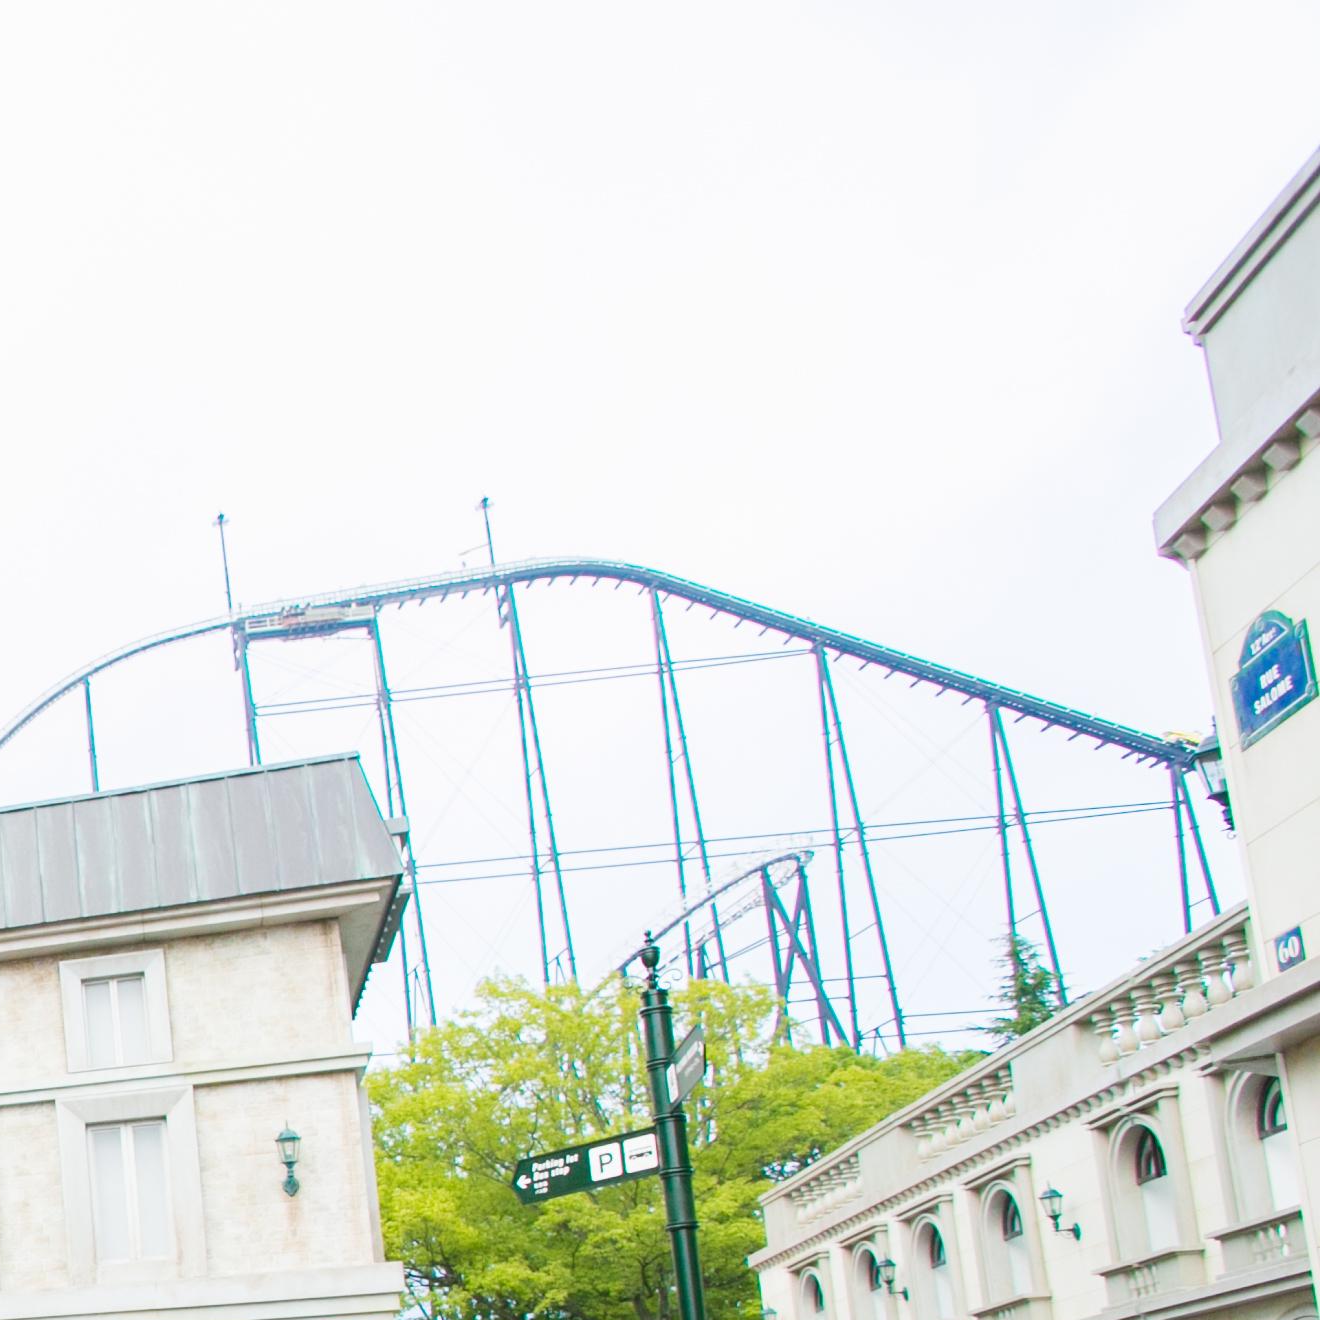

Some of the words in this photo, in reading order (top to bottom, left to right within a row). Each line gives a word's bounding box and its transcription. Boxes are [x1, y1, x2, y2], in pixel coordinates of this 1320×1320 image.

[1260, 664, 1281, 689] RUE
[1254, 675, 1294, 715] SALOME
[1278, 936, 1300, 963] 60
[599, 1153, 613, 1173] P
